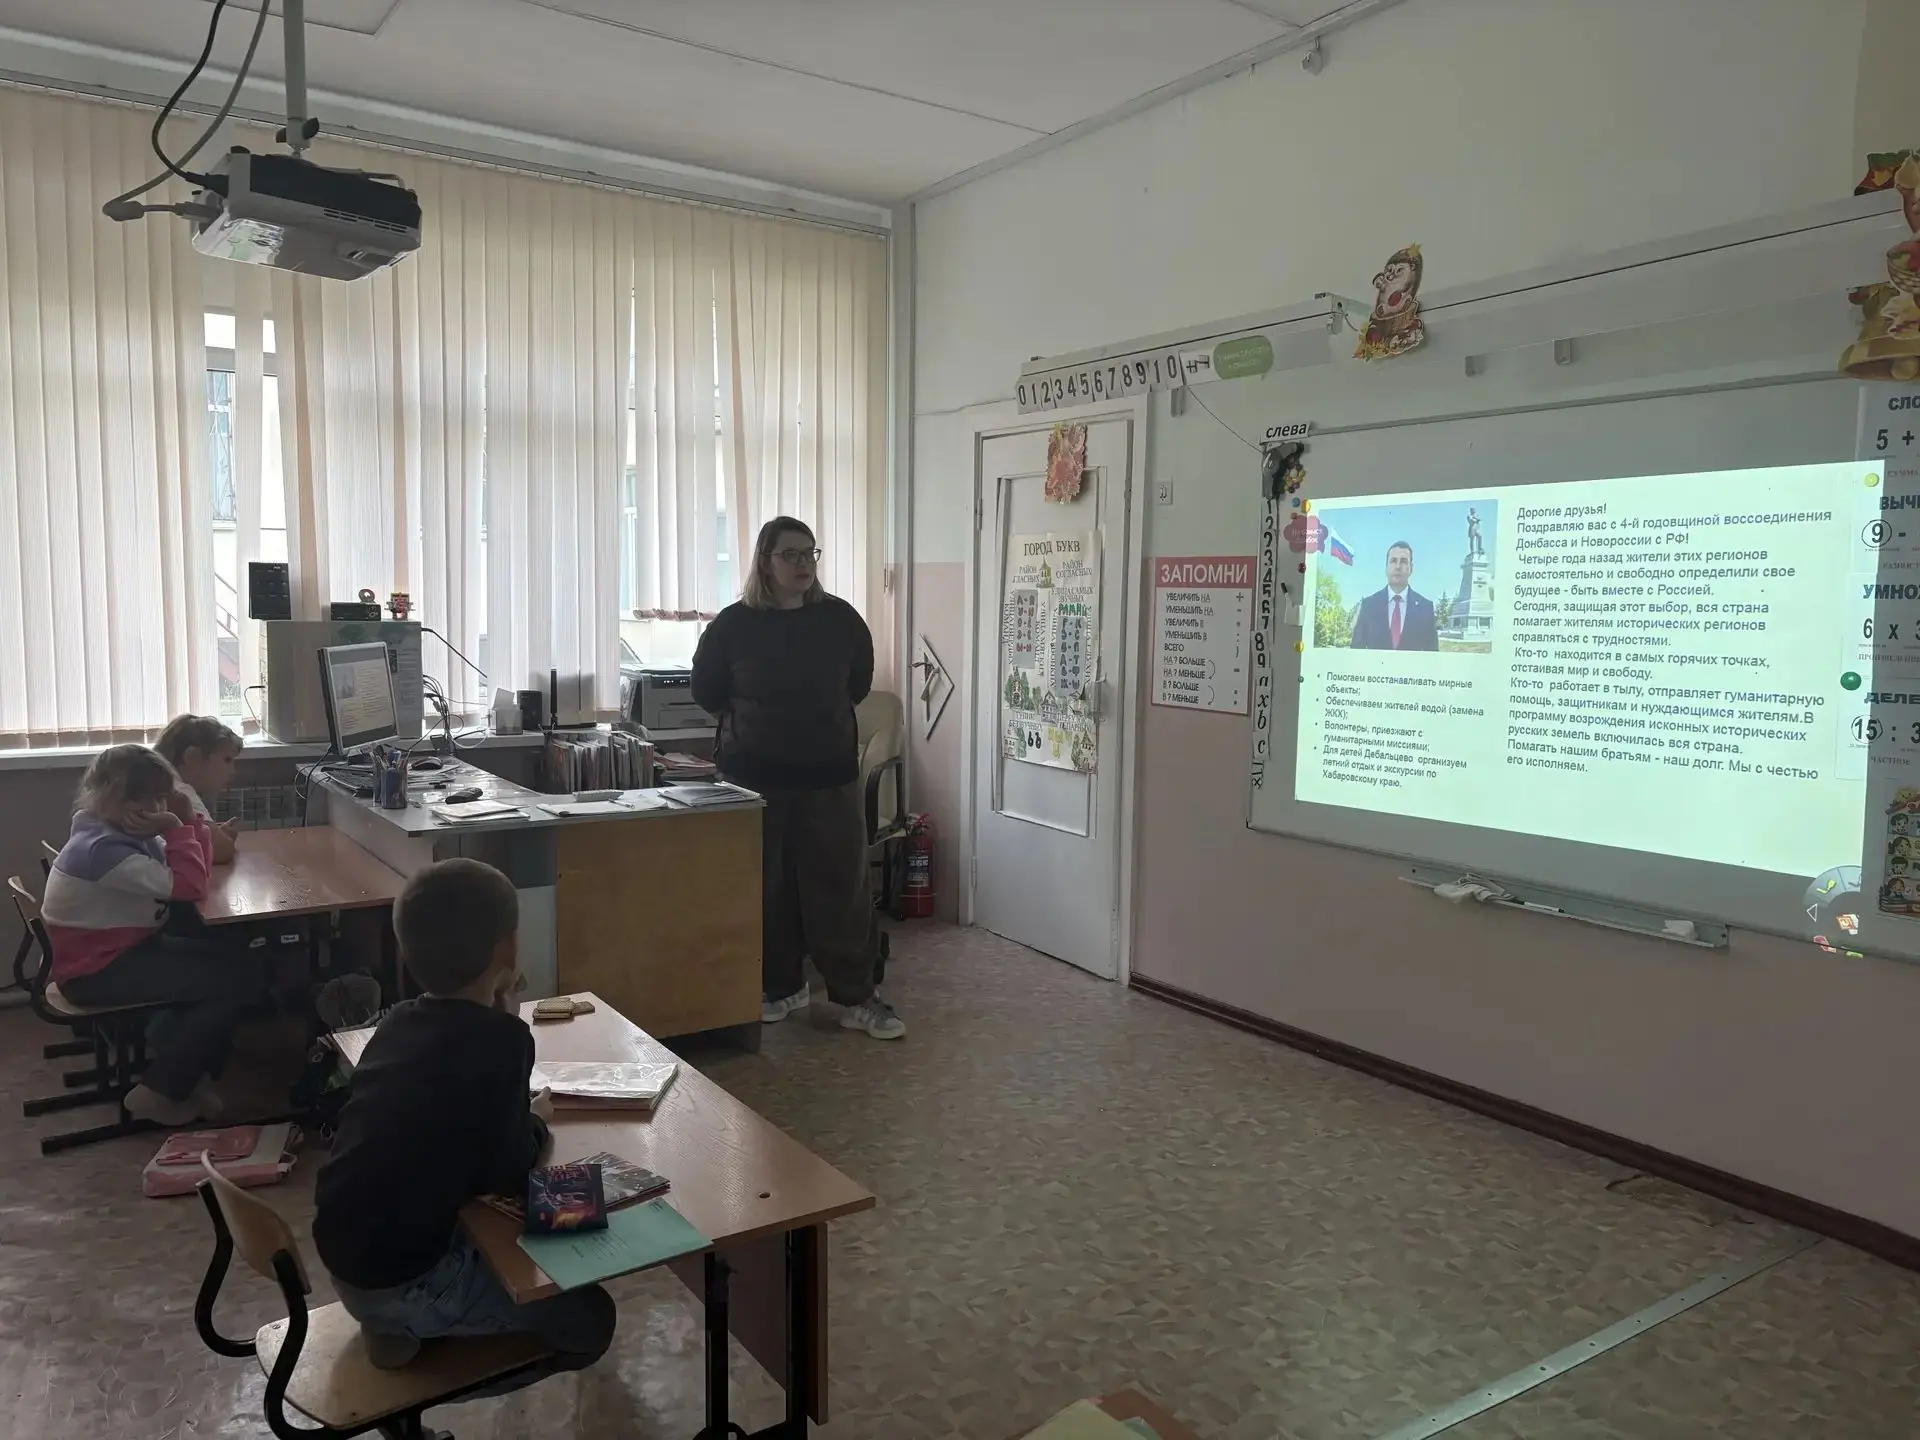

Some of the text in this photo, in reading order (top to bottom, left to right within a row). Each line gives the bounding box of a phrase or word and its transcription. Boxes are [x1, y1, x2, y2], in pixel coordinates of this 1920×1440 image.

[1018, 362, 1147, 406] 0 1 2 3 4 5 6 7 8 9
[1266, 424, 1307, 438] слева
[1877, 429, 1888, 450] 5
[1517, 503, 1607, 520] Дорогие друзья!
[1517, 512, 1832, 534] Поздравляю вас с 4-й годовщиной воссоединения
[1872, 523, 1884, 543] 9
[1024, 541, 1080, 556] ГОРОД БУКВ
[1516, 539, 1568, 551] Донбасса
[1571, 538, 1577, 547] и
[1581, 536, 1651, 548] Новороссии
[1666, 533, 1689, 544] РФ!
[1264, 549, 1272, 566] 3
[1519, 551, 1768, 565] Четыре года назад жители этих регионов
[1161, 564, 1248, 584] ЗАПОМНИ
[1263, 568, 1272, 582] 4
[1515, 570, 1603, 580] самостоятельно
[1618, 568, 1674, 579] свободно
[1679, 568, 1758, 580] определили
[1763, 568, 1795, 577] свое
[1166, 593, 1211, 603] УВЕЛИЧИТЬ НА
[1514, 584, 1714, 597] будущее быть вместе с Россией.
[1863, 584, 1920, 600] УМНО
[1166, 606, 1214, 616] УМЕНЬШИТЬ НА
[1514, 601, 1769, 615] Сегодня, защищая этот выбор, вся страна
[1165, 618, 1199, 627] УВЕЛИЧИТЬ
[1513, 617, 1766, 632] помагает жителям исторических регионов
[1863, 618, 1872, 639] 6
[1165, 631, 1202, 640] УМЕНЬШИТЬ
[1255, 632, 1264, 651] 8
[1512, 633, 1671, 646] справляться с трудностями.
[1165, 643, 1184, 652] ВСЕГО
[1164, 656, 1206, 666] НА БОЛЬШЕ
[1515, 648, 1548, 658] Кто-то
[1554, 651, 1611, 661] находится
[1625, 653, 1664, 663] самых
[1668, 654, 1718, 665] горячих
[1721, 656, 1770, 668] точках,
[1164, 668, 1205, 679] НА МЕНЬШЕ
[1511, 664, 1564, 674] отстаивая
[1568, 666, 1589, 677] мир
[1603, 667, 1653, 680] свободу.
[1173, 682, 1199, 691] БОЛЬШЕ
[1327, 672, 1472, 689] Помогаем восстанавливать мирные
[1326, 685, 1360, 695] объекты;
[1511, 678, 1543, 689] Кто-то
[1550, 681, 1600, 694] работает
[1613, 686, 1644, 696] тылу,
[1648, 687, 1722, 700] отправляет
[1725, 691, 1824, 707] гуманитарную
[1172, 694, 1199, 704] МЕНЬШЕ
[1326, 697, 1484, 716] Обеспечиваем жителей водой (замена
[1510, 695, 1554, 707] помощь,
[1558, 698, 1627, 711] защитникам
[1631, 703, 1637, 711] и
[1642, 702, 1734, 718] нуждающимся
[1325, 708, 1348, 720] ЖКХ);
[1372, 727, 1416, 737] приезжают
[1509, 710, 1806, 741] программу возрождения исконных исторических
[1854, 718, 1920, 744] 15 3
[1324, 735, 1430, 752] гуманитарными миссиями;
[1508, 725, 1742, 754] русских земель включилась вся страна.
[1323, 745, 1467, 768] Для детей Дебальцево организуем
[1507, 756, 1588, 772] его исполняем.
[1508, 739, 1818, 779] Помагать нашим братьям наш долг. Мы с честью
[1323, 758, 1349, 768] летний
[1351, 762, 1374, 772] отдых
[1384, 766, 1424, 777] экскурсии
[1427, 770, 1436, 778] по
[1323, 770, 1377, 786] Хабаровскому
